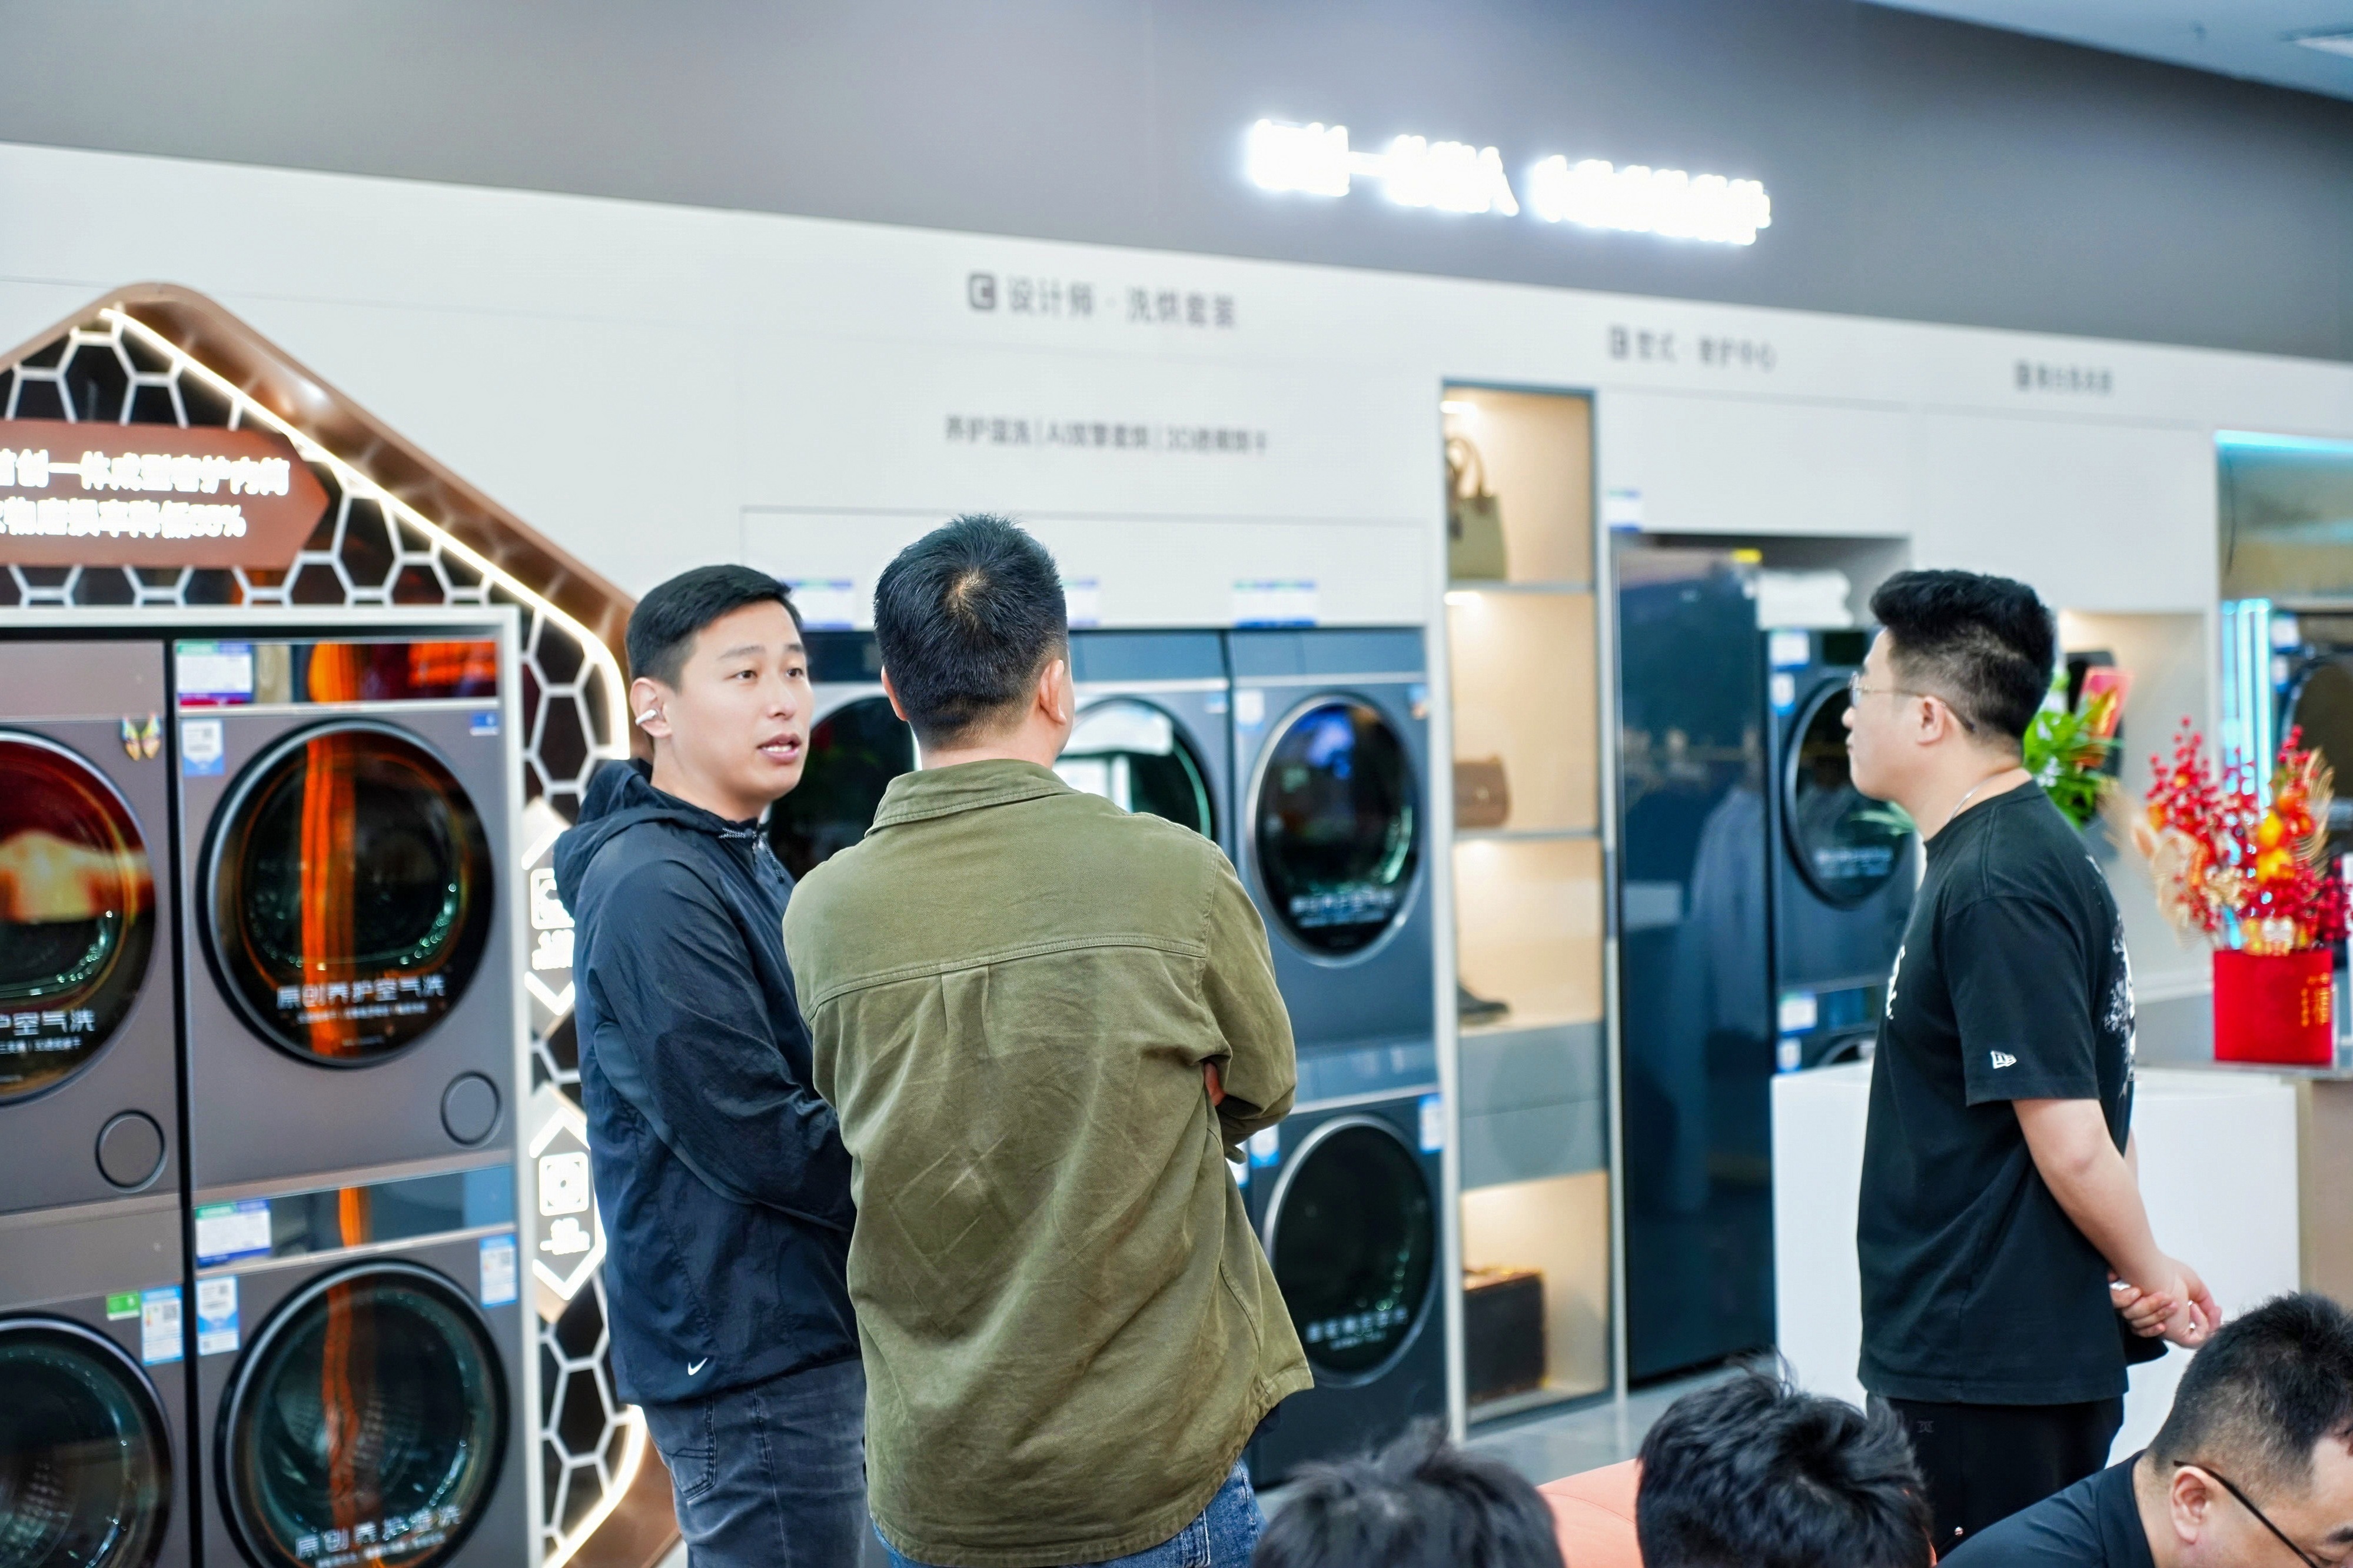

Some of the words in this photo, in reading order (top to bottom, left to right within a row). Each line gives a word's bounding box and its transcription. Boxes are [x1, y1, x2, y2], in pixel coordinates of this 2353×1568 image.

[277, 973, 446, 1009] 原创养护空气洗
